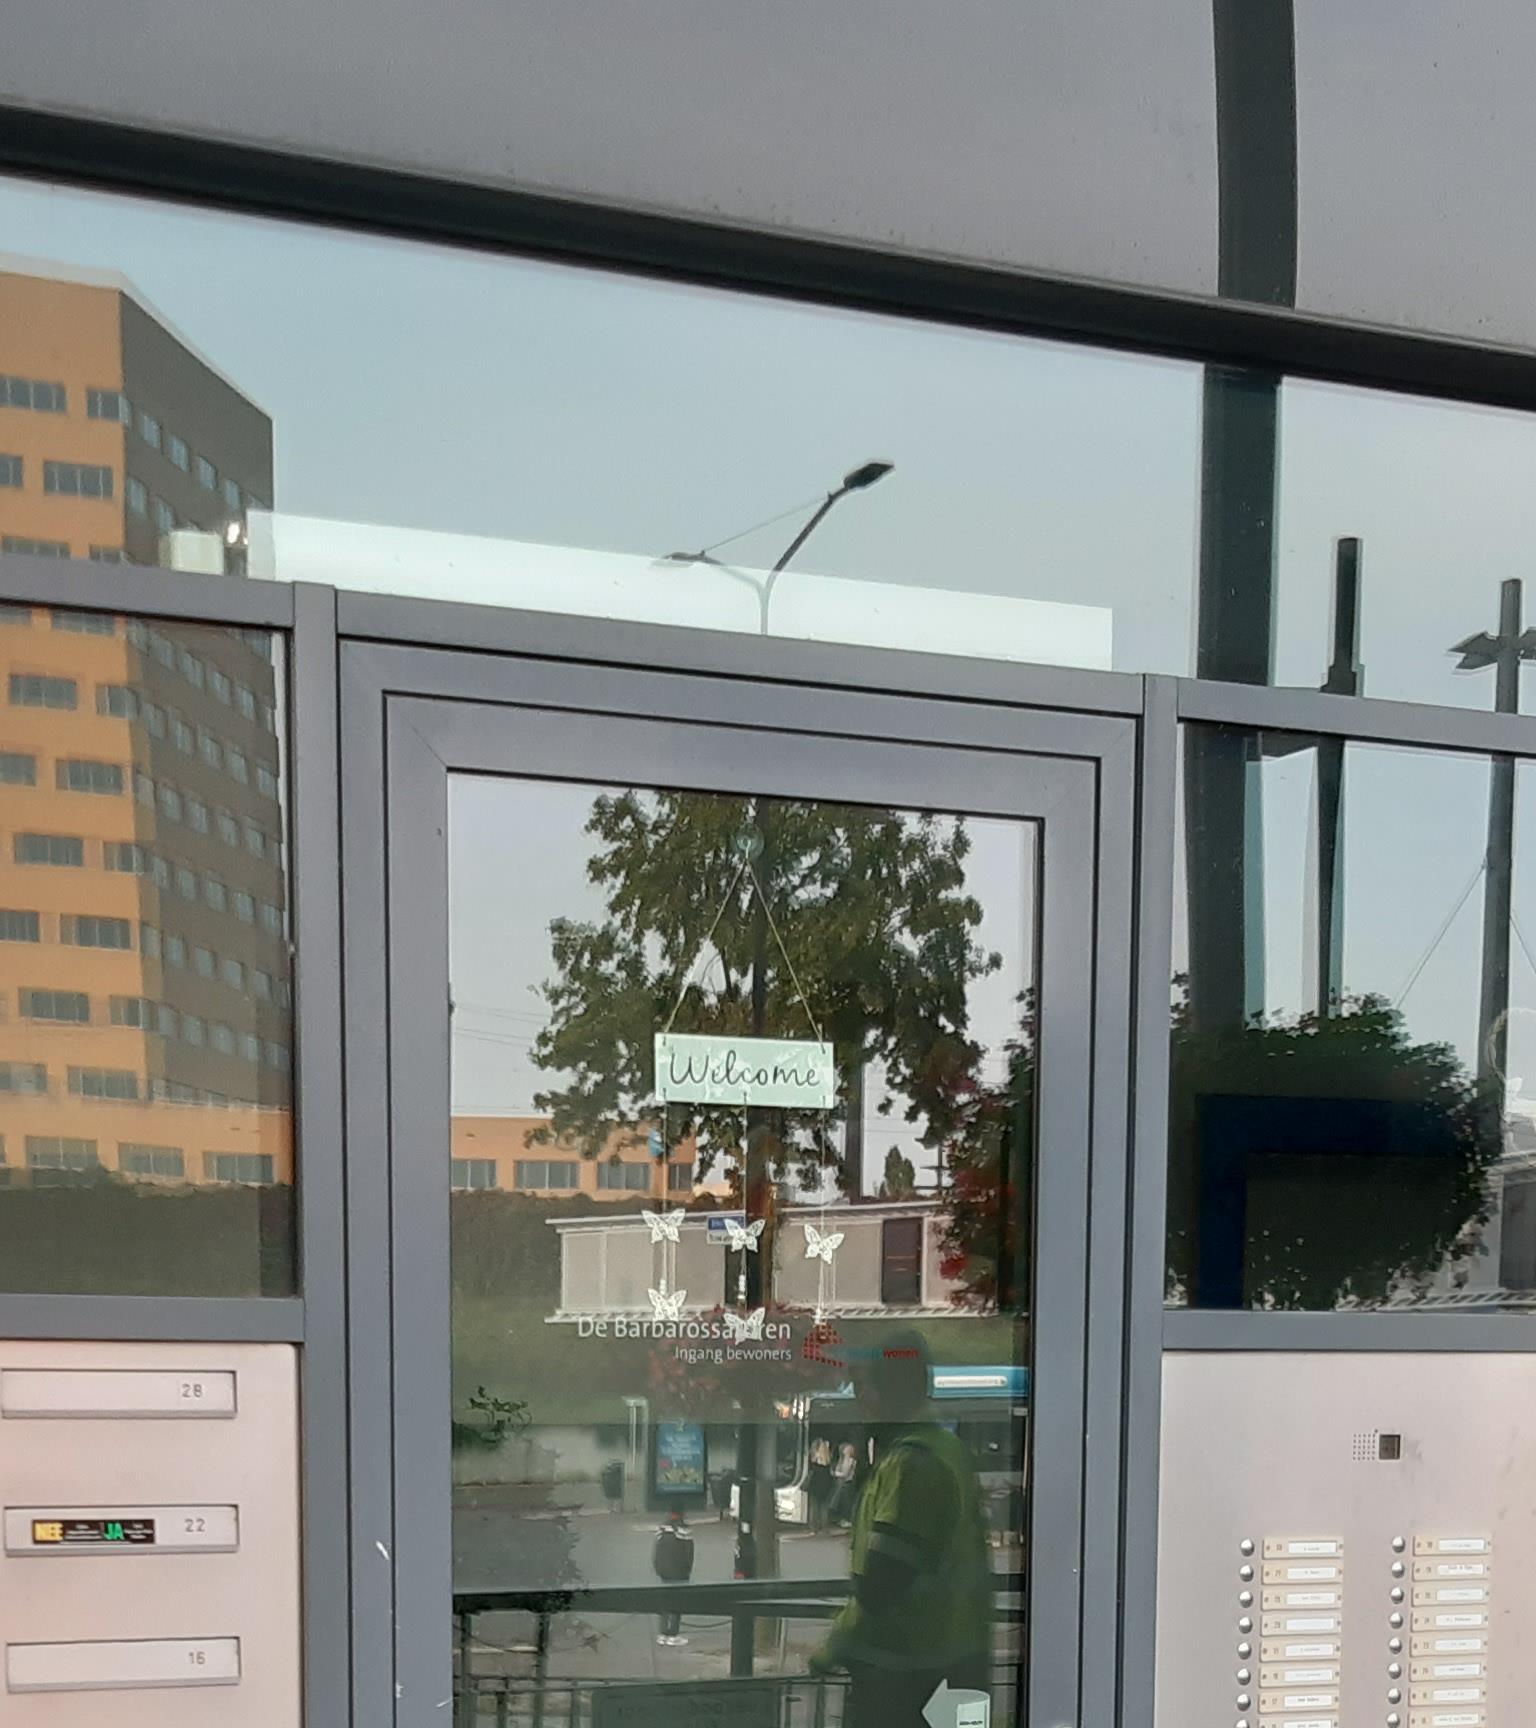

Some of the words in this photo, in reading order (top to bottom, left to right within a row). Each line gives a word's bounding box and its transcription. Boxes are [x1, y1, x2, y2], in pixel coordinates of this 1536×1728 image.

[669, 1045, 821, 1087] Welcome
[577, 1317, 609, 1339] De
[675, 1346, 724, 1365] Ingang
[726, 1346, 793, 1361] bewoners
[181, 1383, 204, 1398] 28
[103, 1522, 125, 1541] JA
[184, 1518, 207, 1533] 22
[188, 1651, 206, 1665] 16
